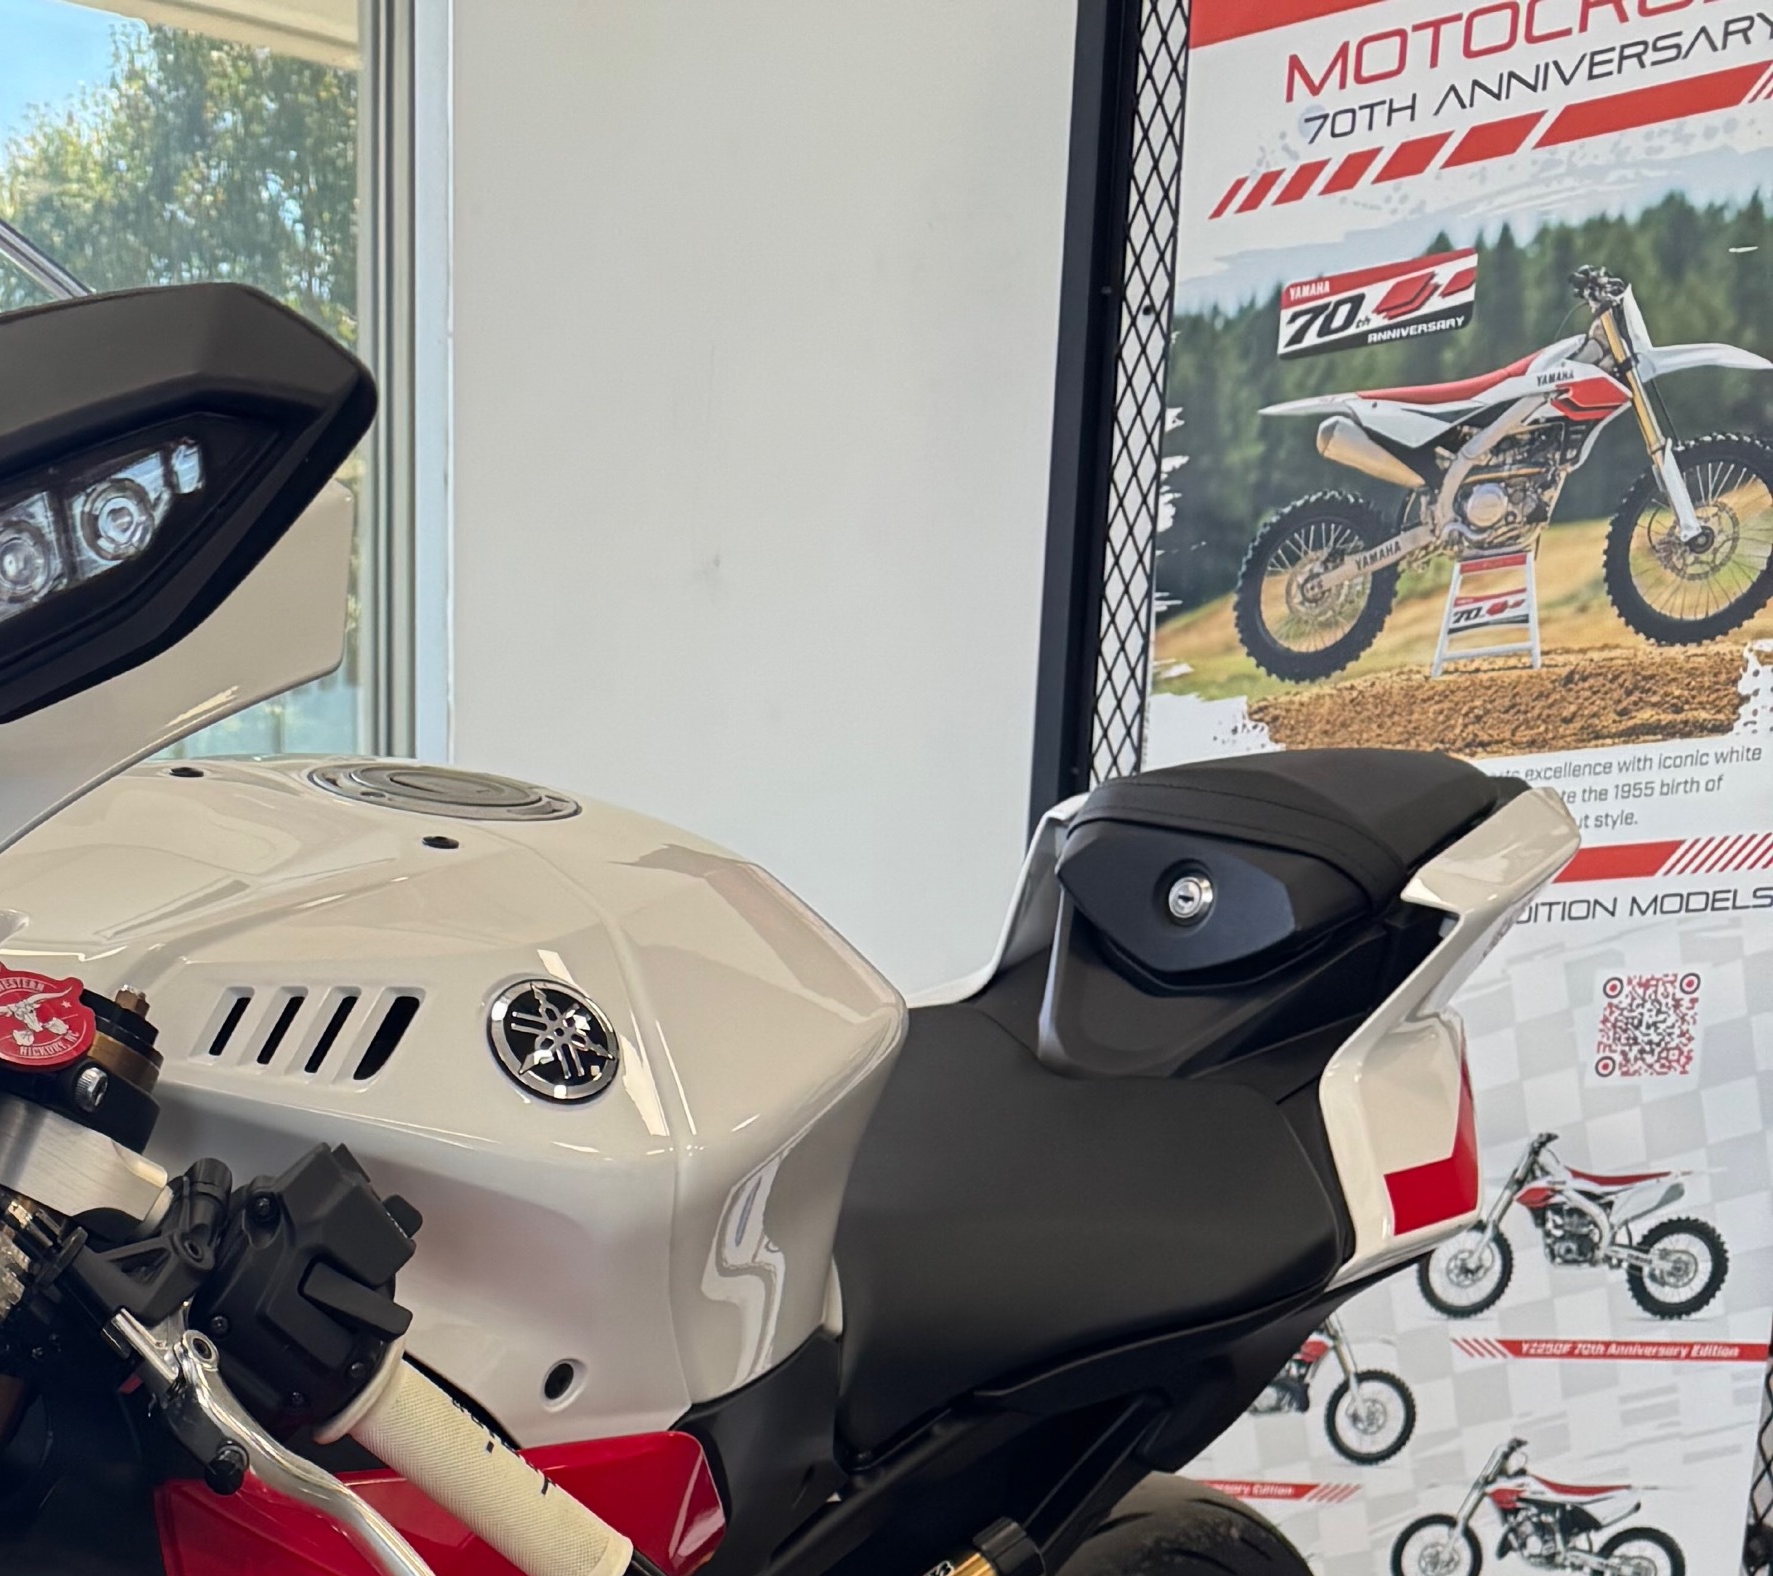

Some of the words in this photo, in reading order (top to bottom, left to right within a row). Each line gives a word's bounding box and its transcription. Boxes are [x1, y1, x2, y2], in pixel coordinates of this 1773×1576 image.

[1304, 94, 1416, 144] 70TH
[1289, 281, 1330, 301] YAMAHA
[1367, 316, 1465, 344] ANNIVERSARY
[1536, 369, 1574, 386] YAMAHA
[1354, 539, 1402, 571] YAMAHA
[1525, 760, 1613, 781] excellence
[1617, 755, 1654, 774] with
[1658, 750, 1710, 770] iconic
[1714, 745, 1762, 765] white
[1581, 785, 1608, 803] the
[1614, 781, 1655, 800] 1955
[1660, 777, 1700, 796] birth
[1705, 774, 1724, 792] of
[1594, 809, 1638, 830] style.
[1629, 886, 1773, 918] MODELS
[20, 1040, 71, 1056] HICKORY,
[1574, 1341, 1603, 1356] 70th
[1607, 1342, 1687, 1359] Anniversary
[1691, 1343, 1739, 1358] Edition
